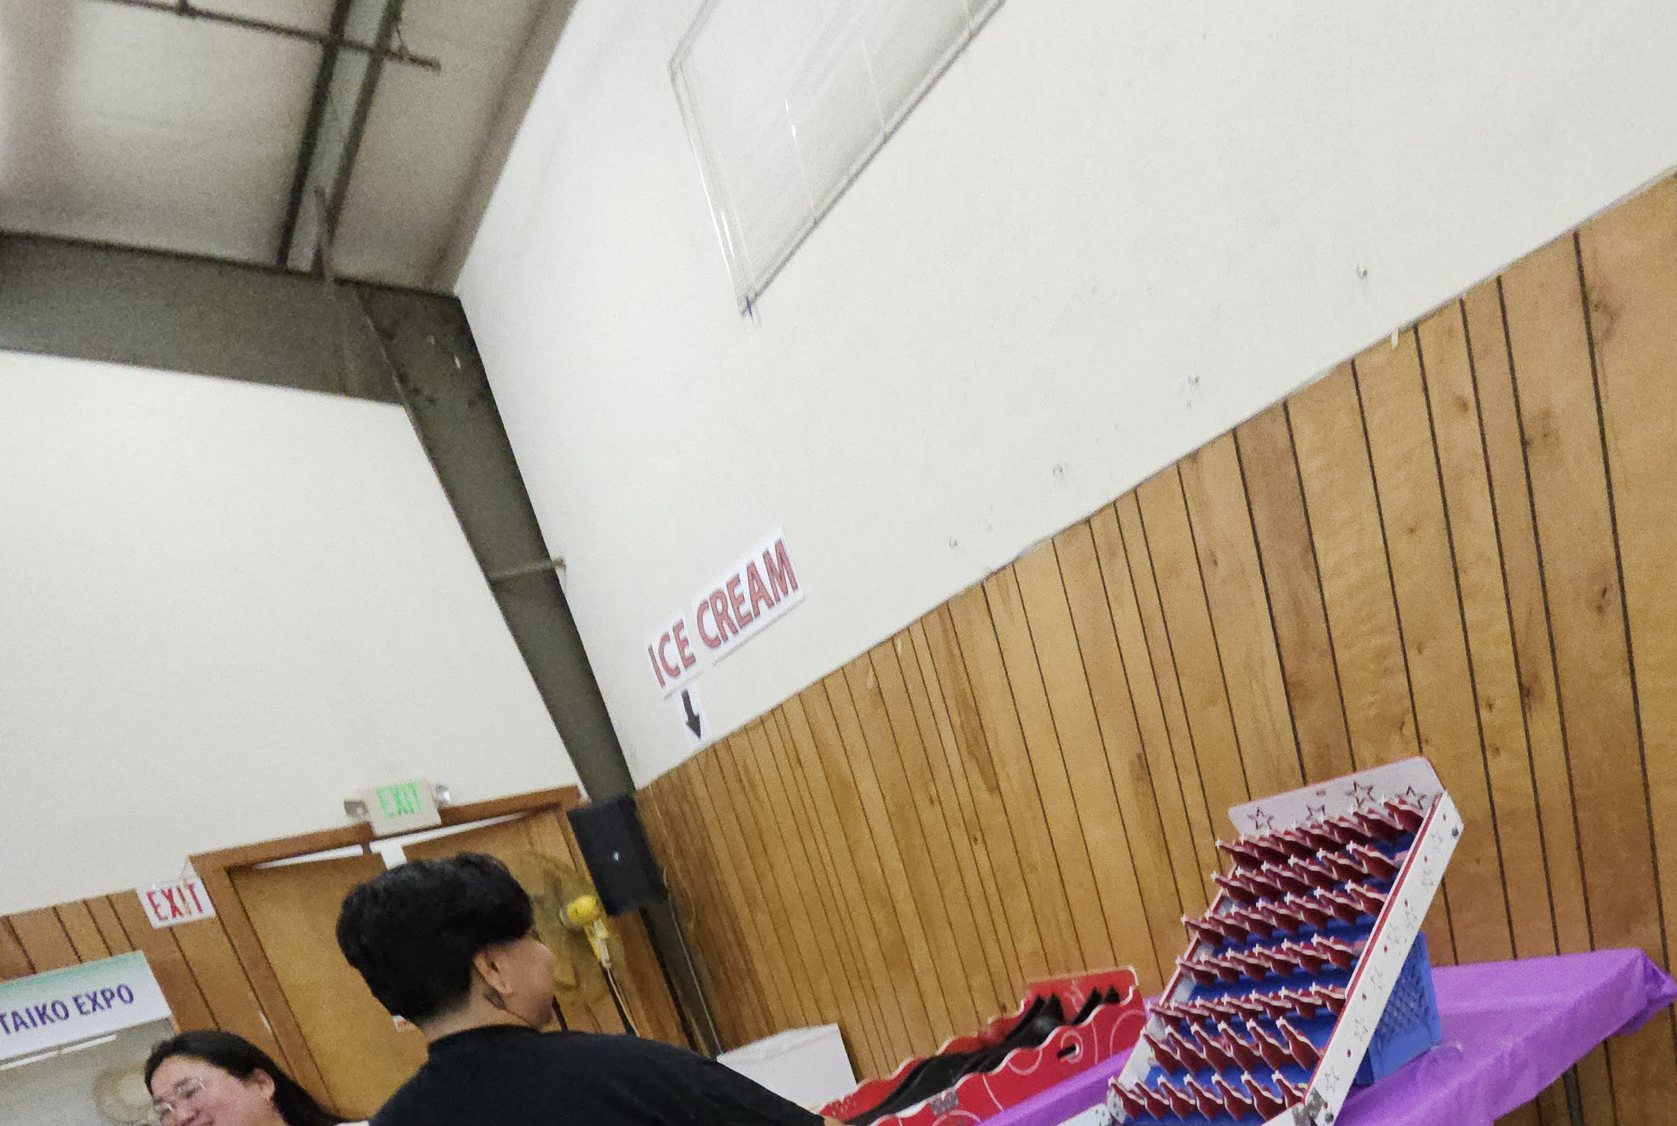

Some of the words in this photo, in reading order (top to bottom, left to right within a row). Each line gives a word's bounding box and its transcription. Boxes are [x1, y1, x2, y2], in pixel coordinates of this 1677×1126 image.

[648, 619, 696, 688] ICE
[697, 539, 798, 649] CREAM
[376, 781, 424, 819] EXIT
[146, 882, 204, 922] EXIT
[0, 999, 70, 1035] TAIKO
[72, 983, 135, 1016] EXPO
